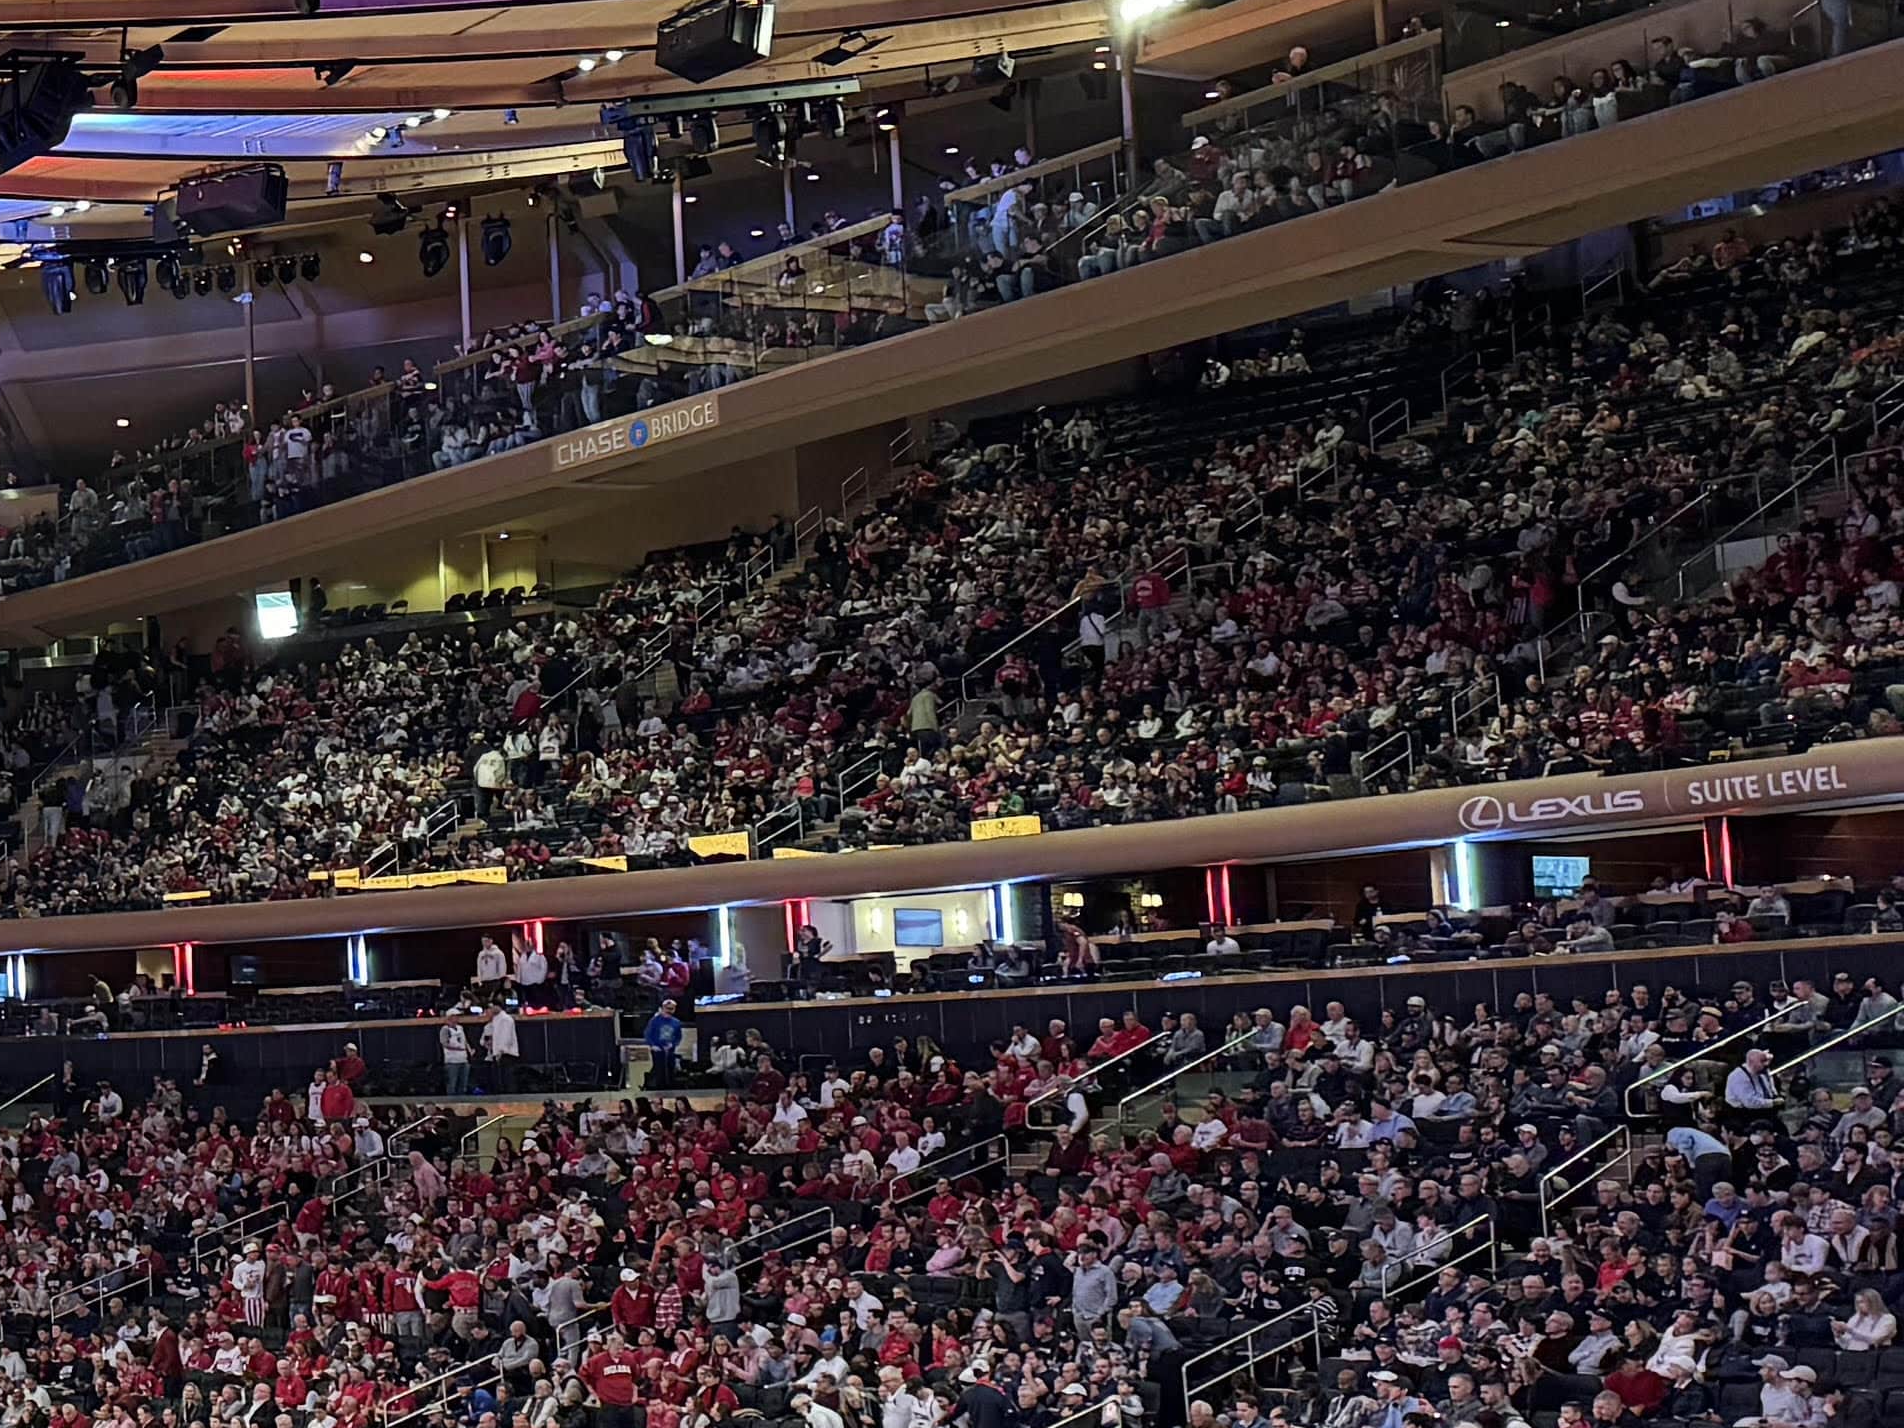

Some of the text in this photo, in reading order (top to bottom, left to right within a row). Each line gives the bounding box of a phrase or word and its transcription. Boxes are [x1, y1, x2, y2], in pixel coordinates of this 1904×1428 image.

[557, 401, 715, 466] CHASE BRIDGE
[1507, 765, 1848, 823] LEXUS SUITE LEVEL
